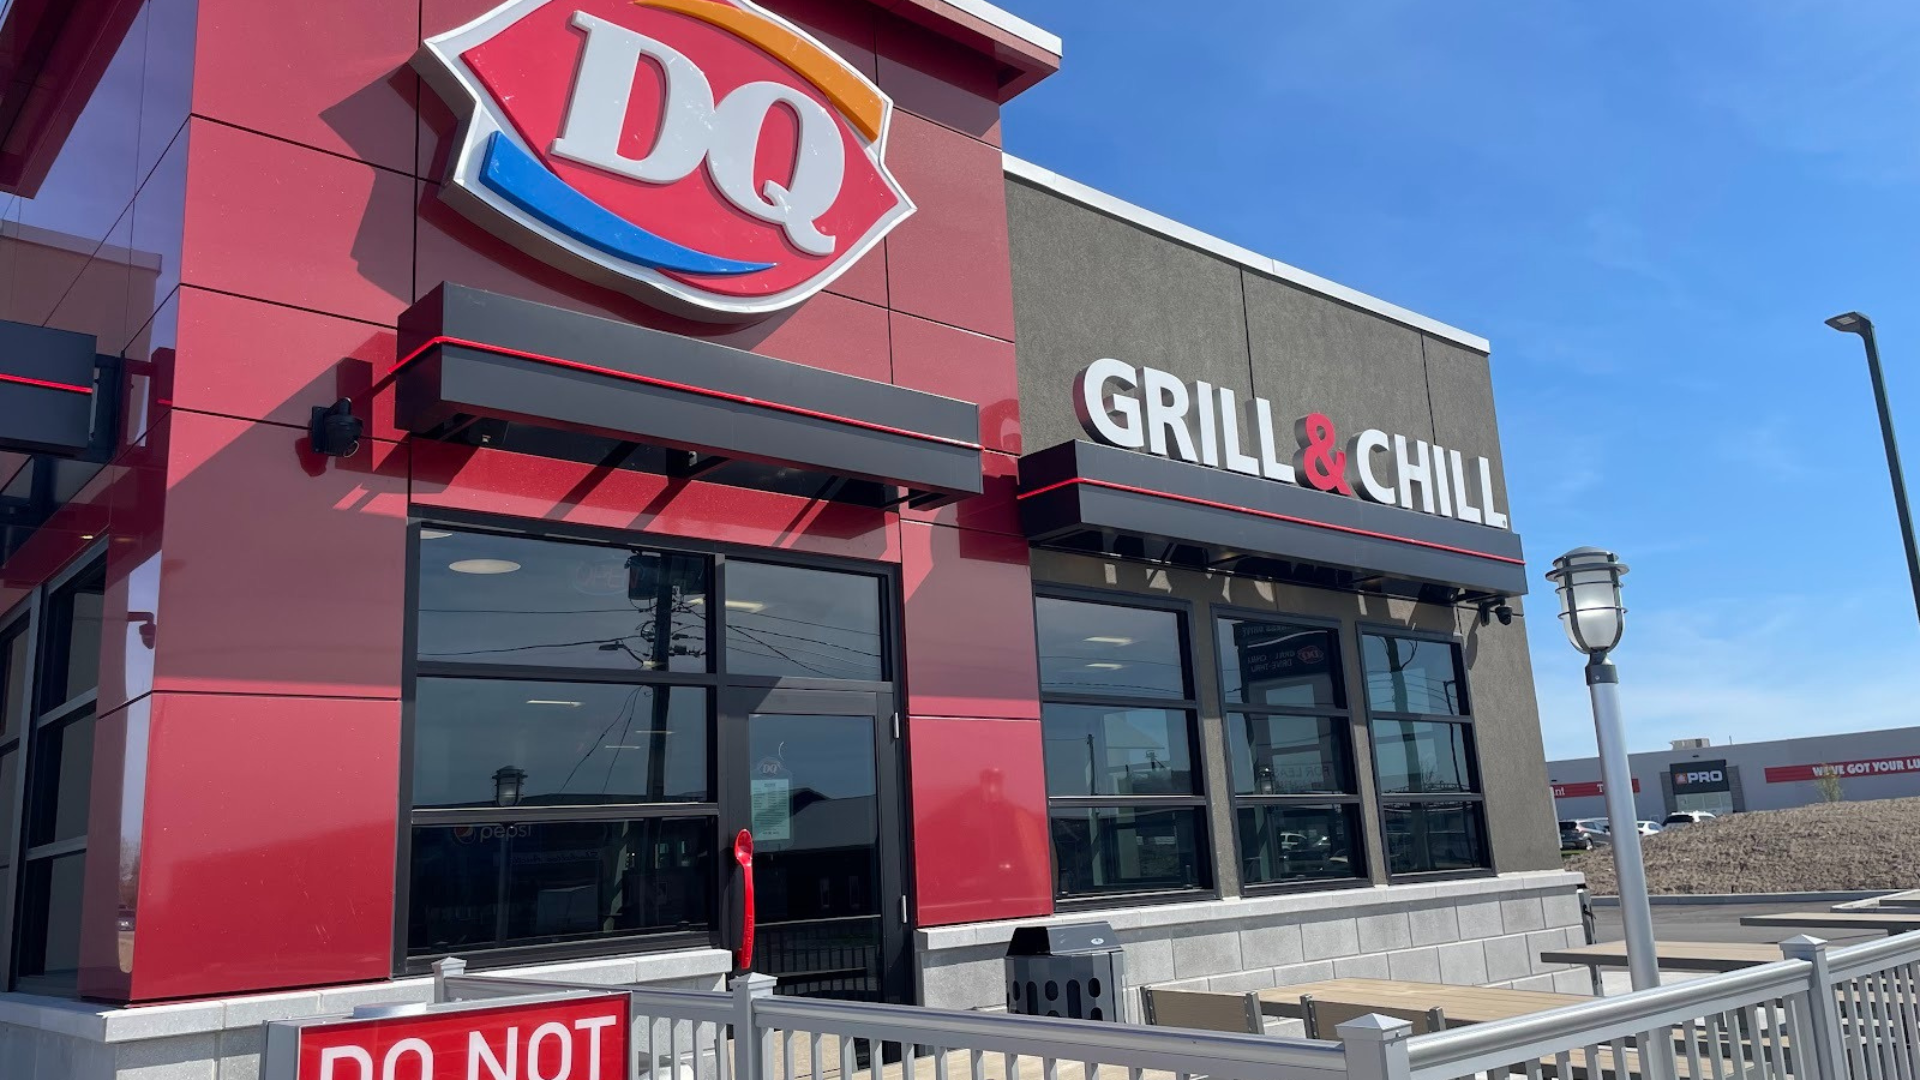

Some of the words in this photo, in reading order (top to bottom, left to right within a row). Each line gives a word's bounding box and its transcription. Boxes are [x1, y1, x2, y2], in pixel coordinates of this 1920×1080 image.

[551, 11, 845, 256] DQ
[1078, 358, 1297, 484] GRILL
[1298, 412, 1353, 496] &
[1353, 428, 1508, 529] CHILL
[1687, 770, 1722, 784] PRO
[1847, 763, 1870, 775] GOT
[1872, 760, 1904, 772] YOUR
[480, 825, 531, 843] pepsi
[320, 1038, 434, 1080] DO
[468, 1015, 616, 1080] NOT
